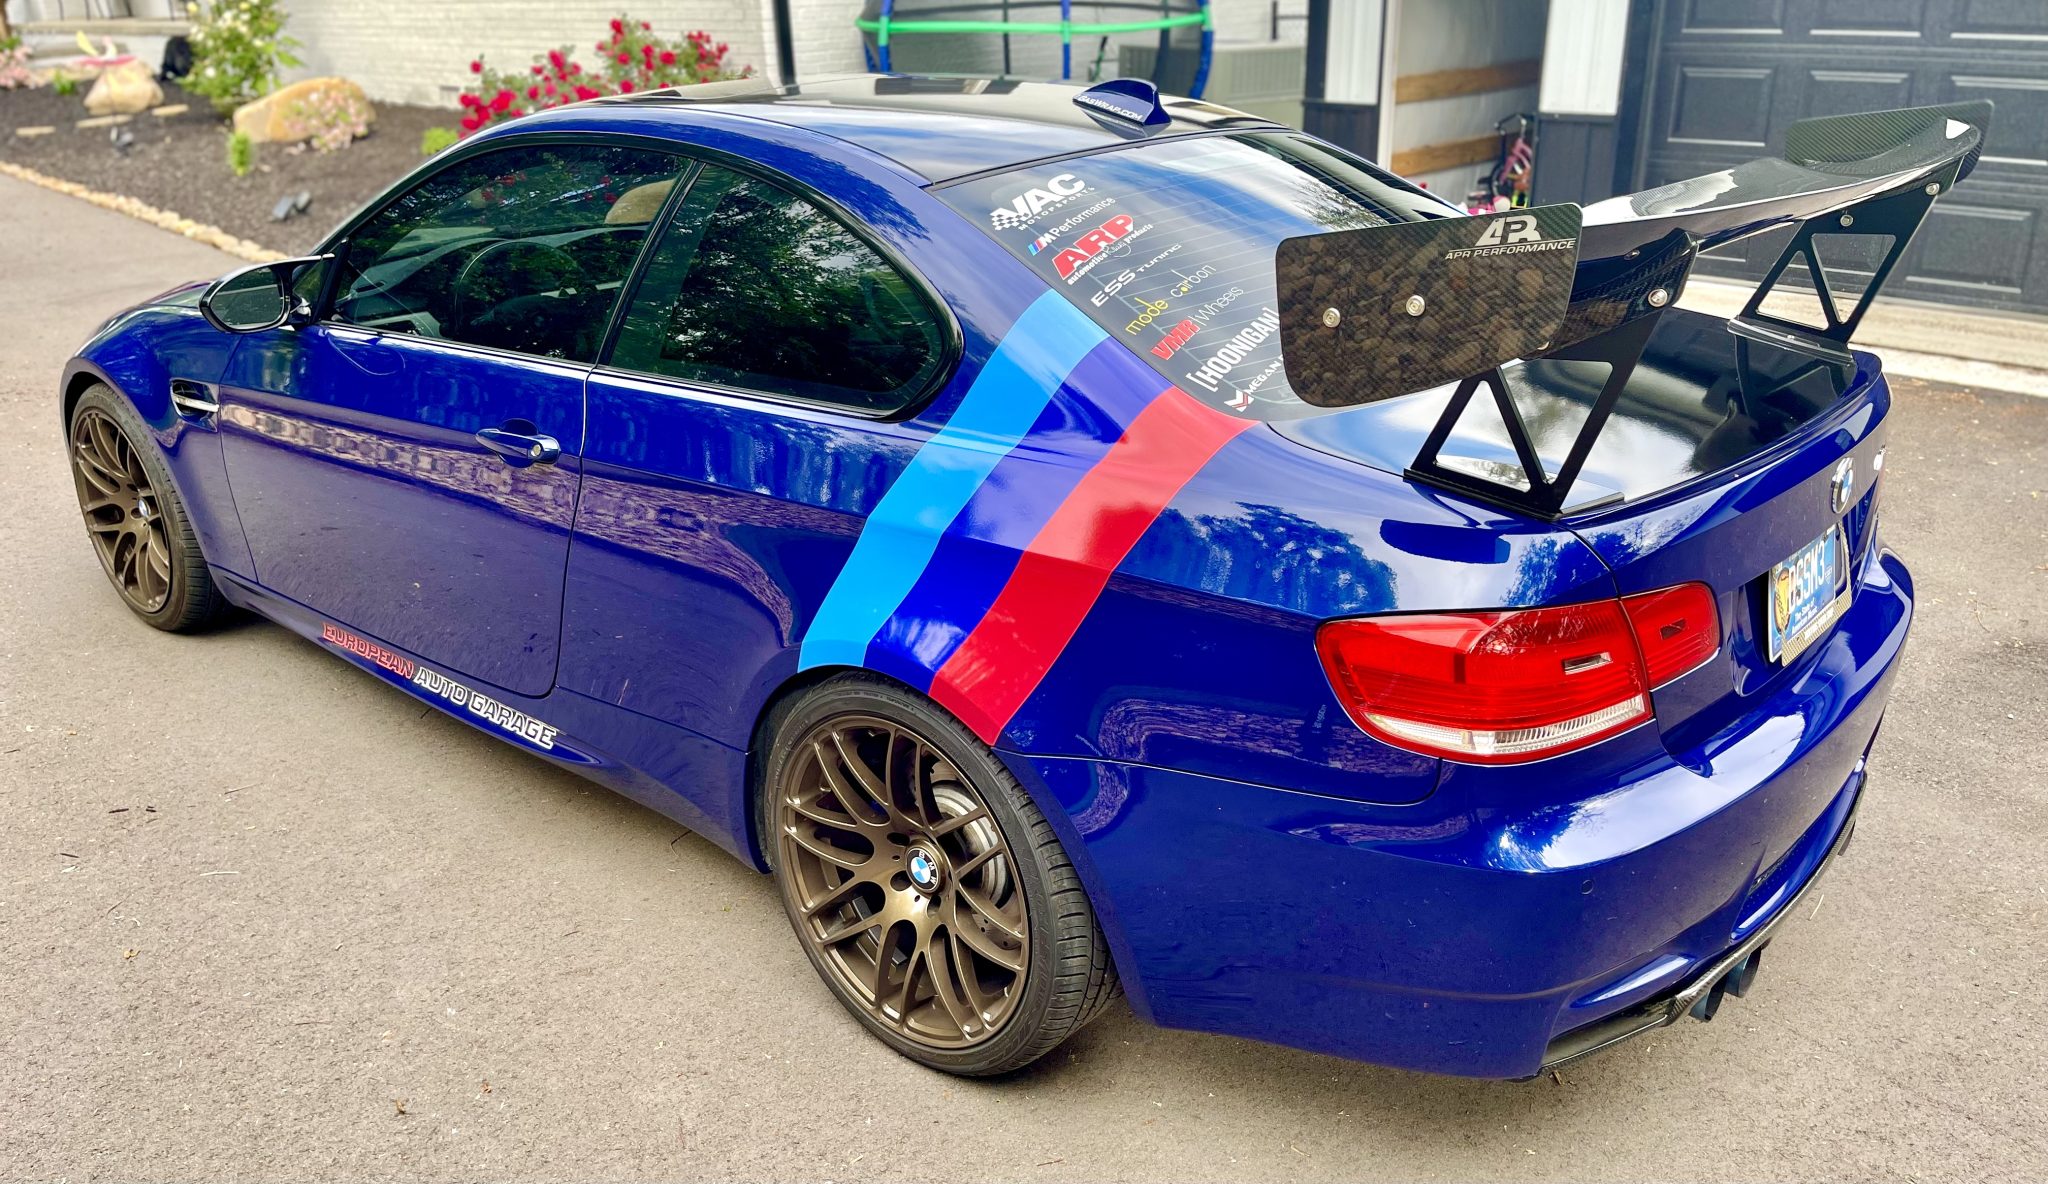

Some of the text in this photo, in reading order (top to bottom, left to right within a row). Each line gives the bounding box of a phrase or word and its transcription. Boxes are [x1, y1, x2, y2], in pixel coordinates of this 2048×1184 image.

[990, 173, 1086, 231] VAC
[1052, 214, 1134, 280] ARP
[1444, 240, 1576, 260] APR PERFORMANCE
[1067, 251, 1109, 286] automotive
[1090, 269, 1136, 308] ESS
[1125, 297, 1168, 336] mode
[1150, 319, 1200, 360] VMR
[323, 622, 558, 749] EUROPEAN AUTO GARAGE
[918, 850, 937, 885] BMW
